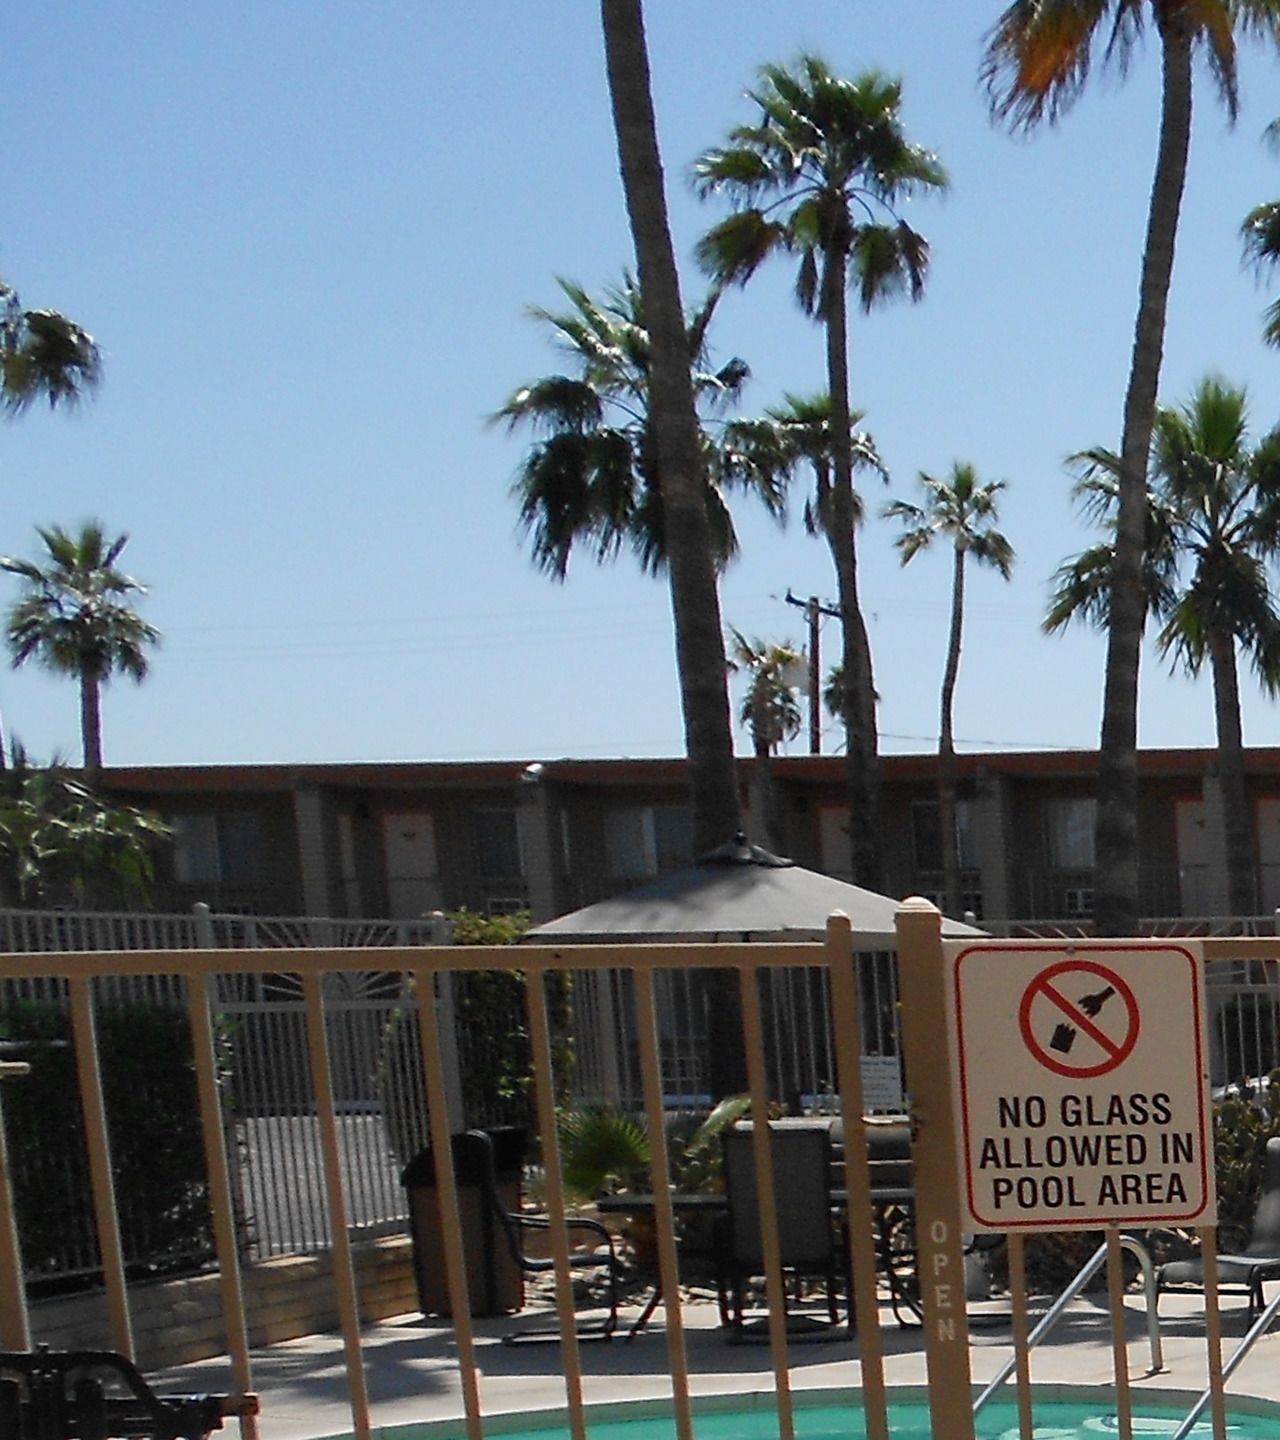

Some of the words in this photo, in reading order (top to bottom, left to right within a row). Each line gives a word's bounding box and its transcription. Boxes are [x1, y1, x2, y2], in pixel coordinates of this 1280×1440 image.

[999, 1095, 1046, 1128] NO
[1060, 1092, 1172, 1127] GLASS
[980, 1134, 1147, 1169] ALLOWED
[1161, 1132, 1194, 1164] IN
[992, 1176, 1085, 1209] POOL
[1099, 1172, 1187, 1204] AREA
[931, 1220, 956, 1342] OPEN
